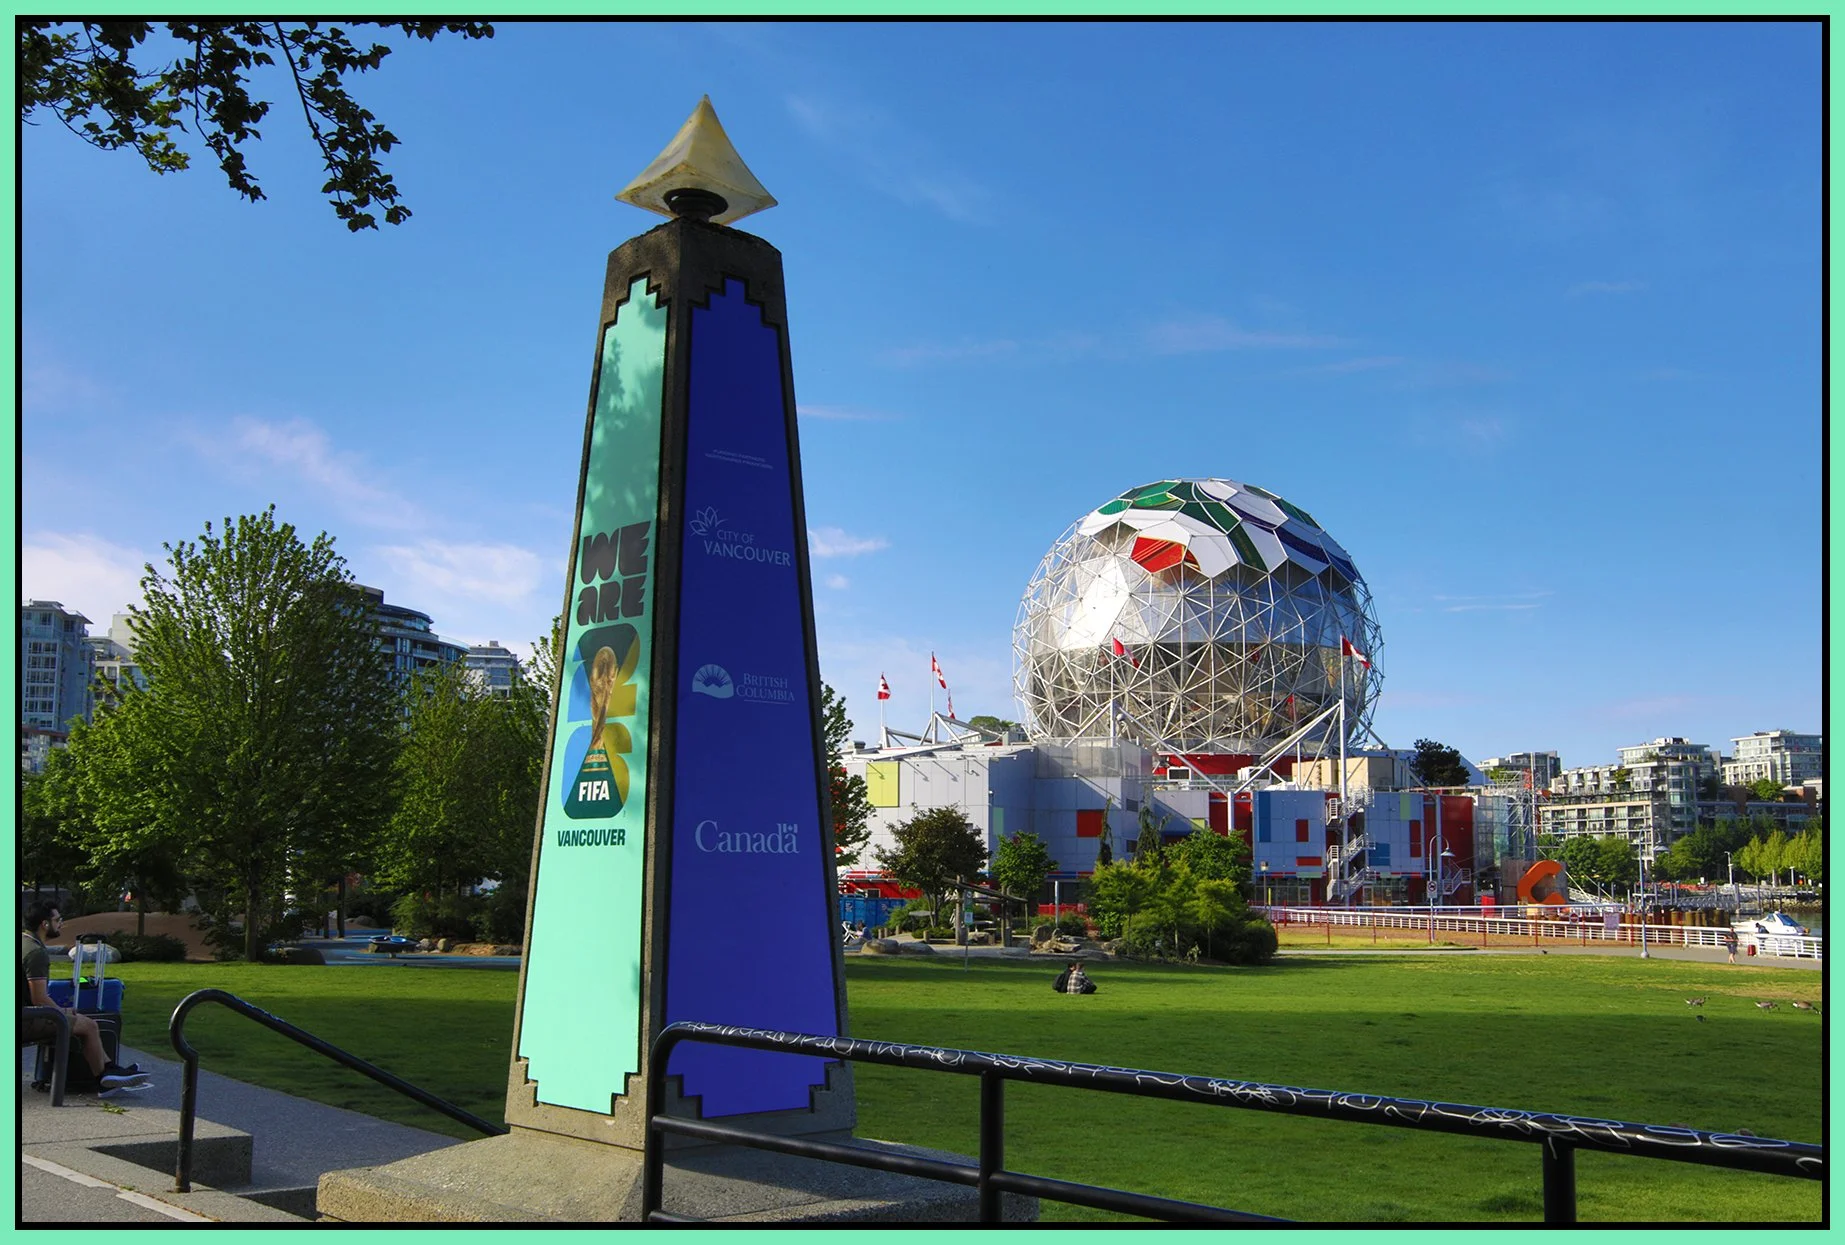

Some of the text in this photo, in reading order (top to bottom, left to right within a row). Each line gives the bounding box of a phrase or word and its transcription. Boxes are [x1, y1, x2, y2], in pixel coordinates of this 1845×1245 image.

[716, 529, 755, 545] CITY OF
[581, 521, 651, 585] WE
[703, 540, 791, 567] VANCOUVER
[743, 672, 788, 689] BRITISH
[736, 686, 795, 702] COLUMBIA
[578, 780, 610, 802] FIFA
[557, 828, 626, 847] VANCOUVER
[695, 819, 800, 854] Canada
